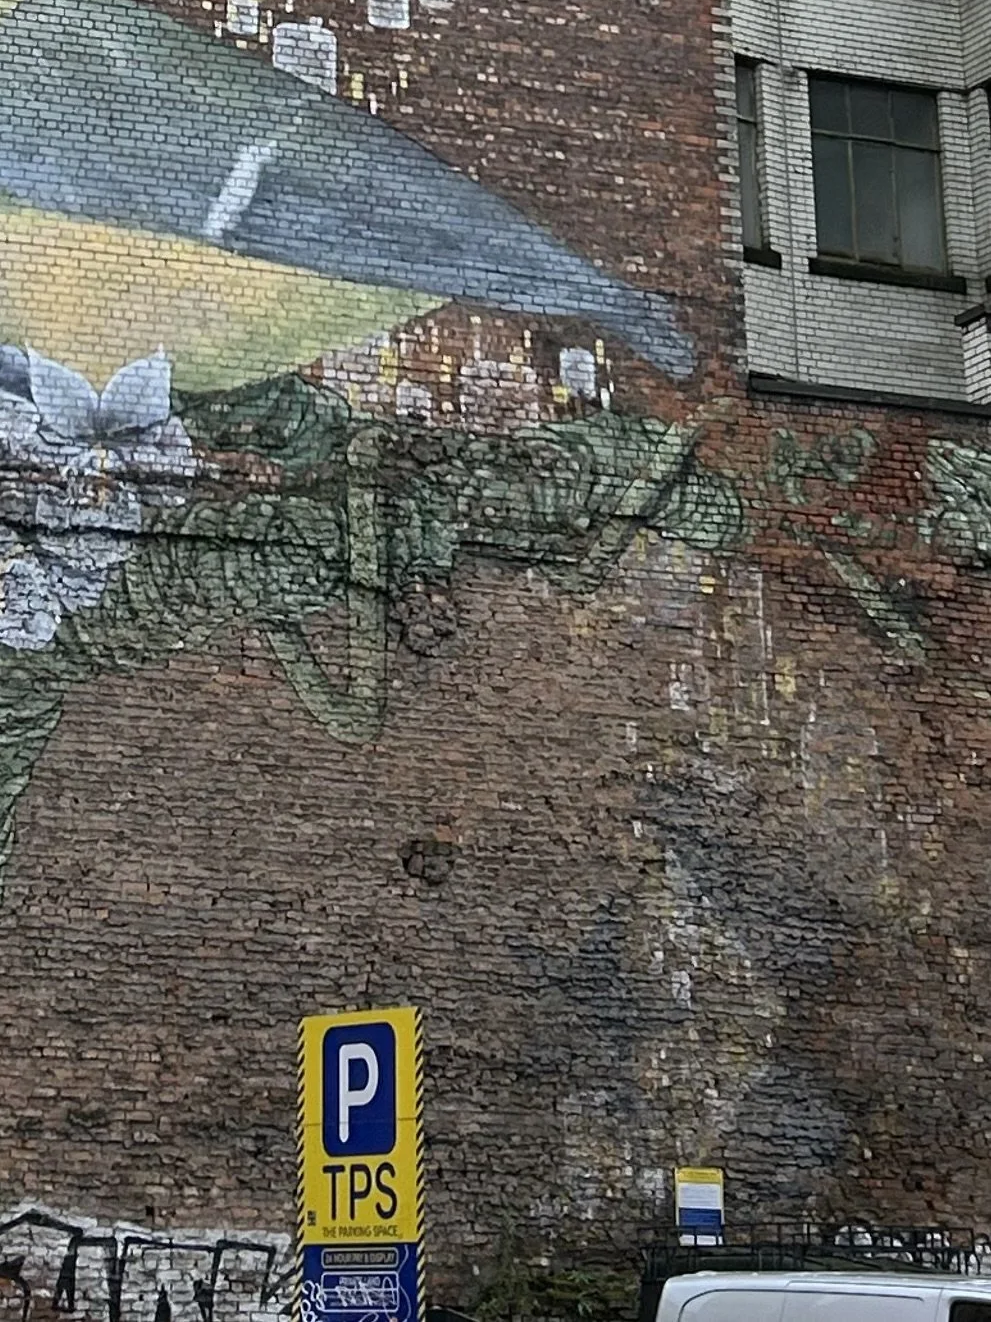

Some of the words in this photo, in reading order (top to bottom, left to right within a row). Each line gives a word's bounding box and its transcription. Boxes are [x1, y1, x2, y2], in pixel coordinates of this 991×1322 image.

[338, 1042, 379, 1143] P
[322, 1161, 398, 1221] TPS
[322, 1226, 337, 1238] THE
[339, 1226, 372, 1238] PARKING
[373, 1225, 398, 1237] SPACE
